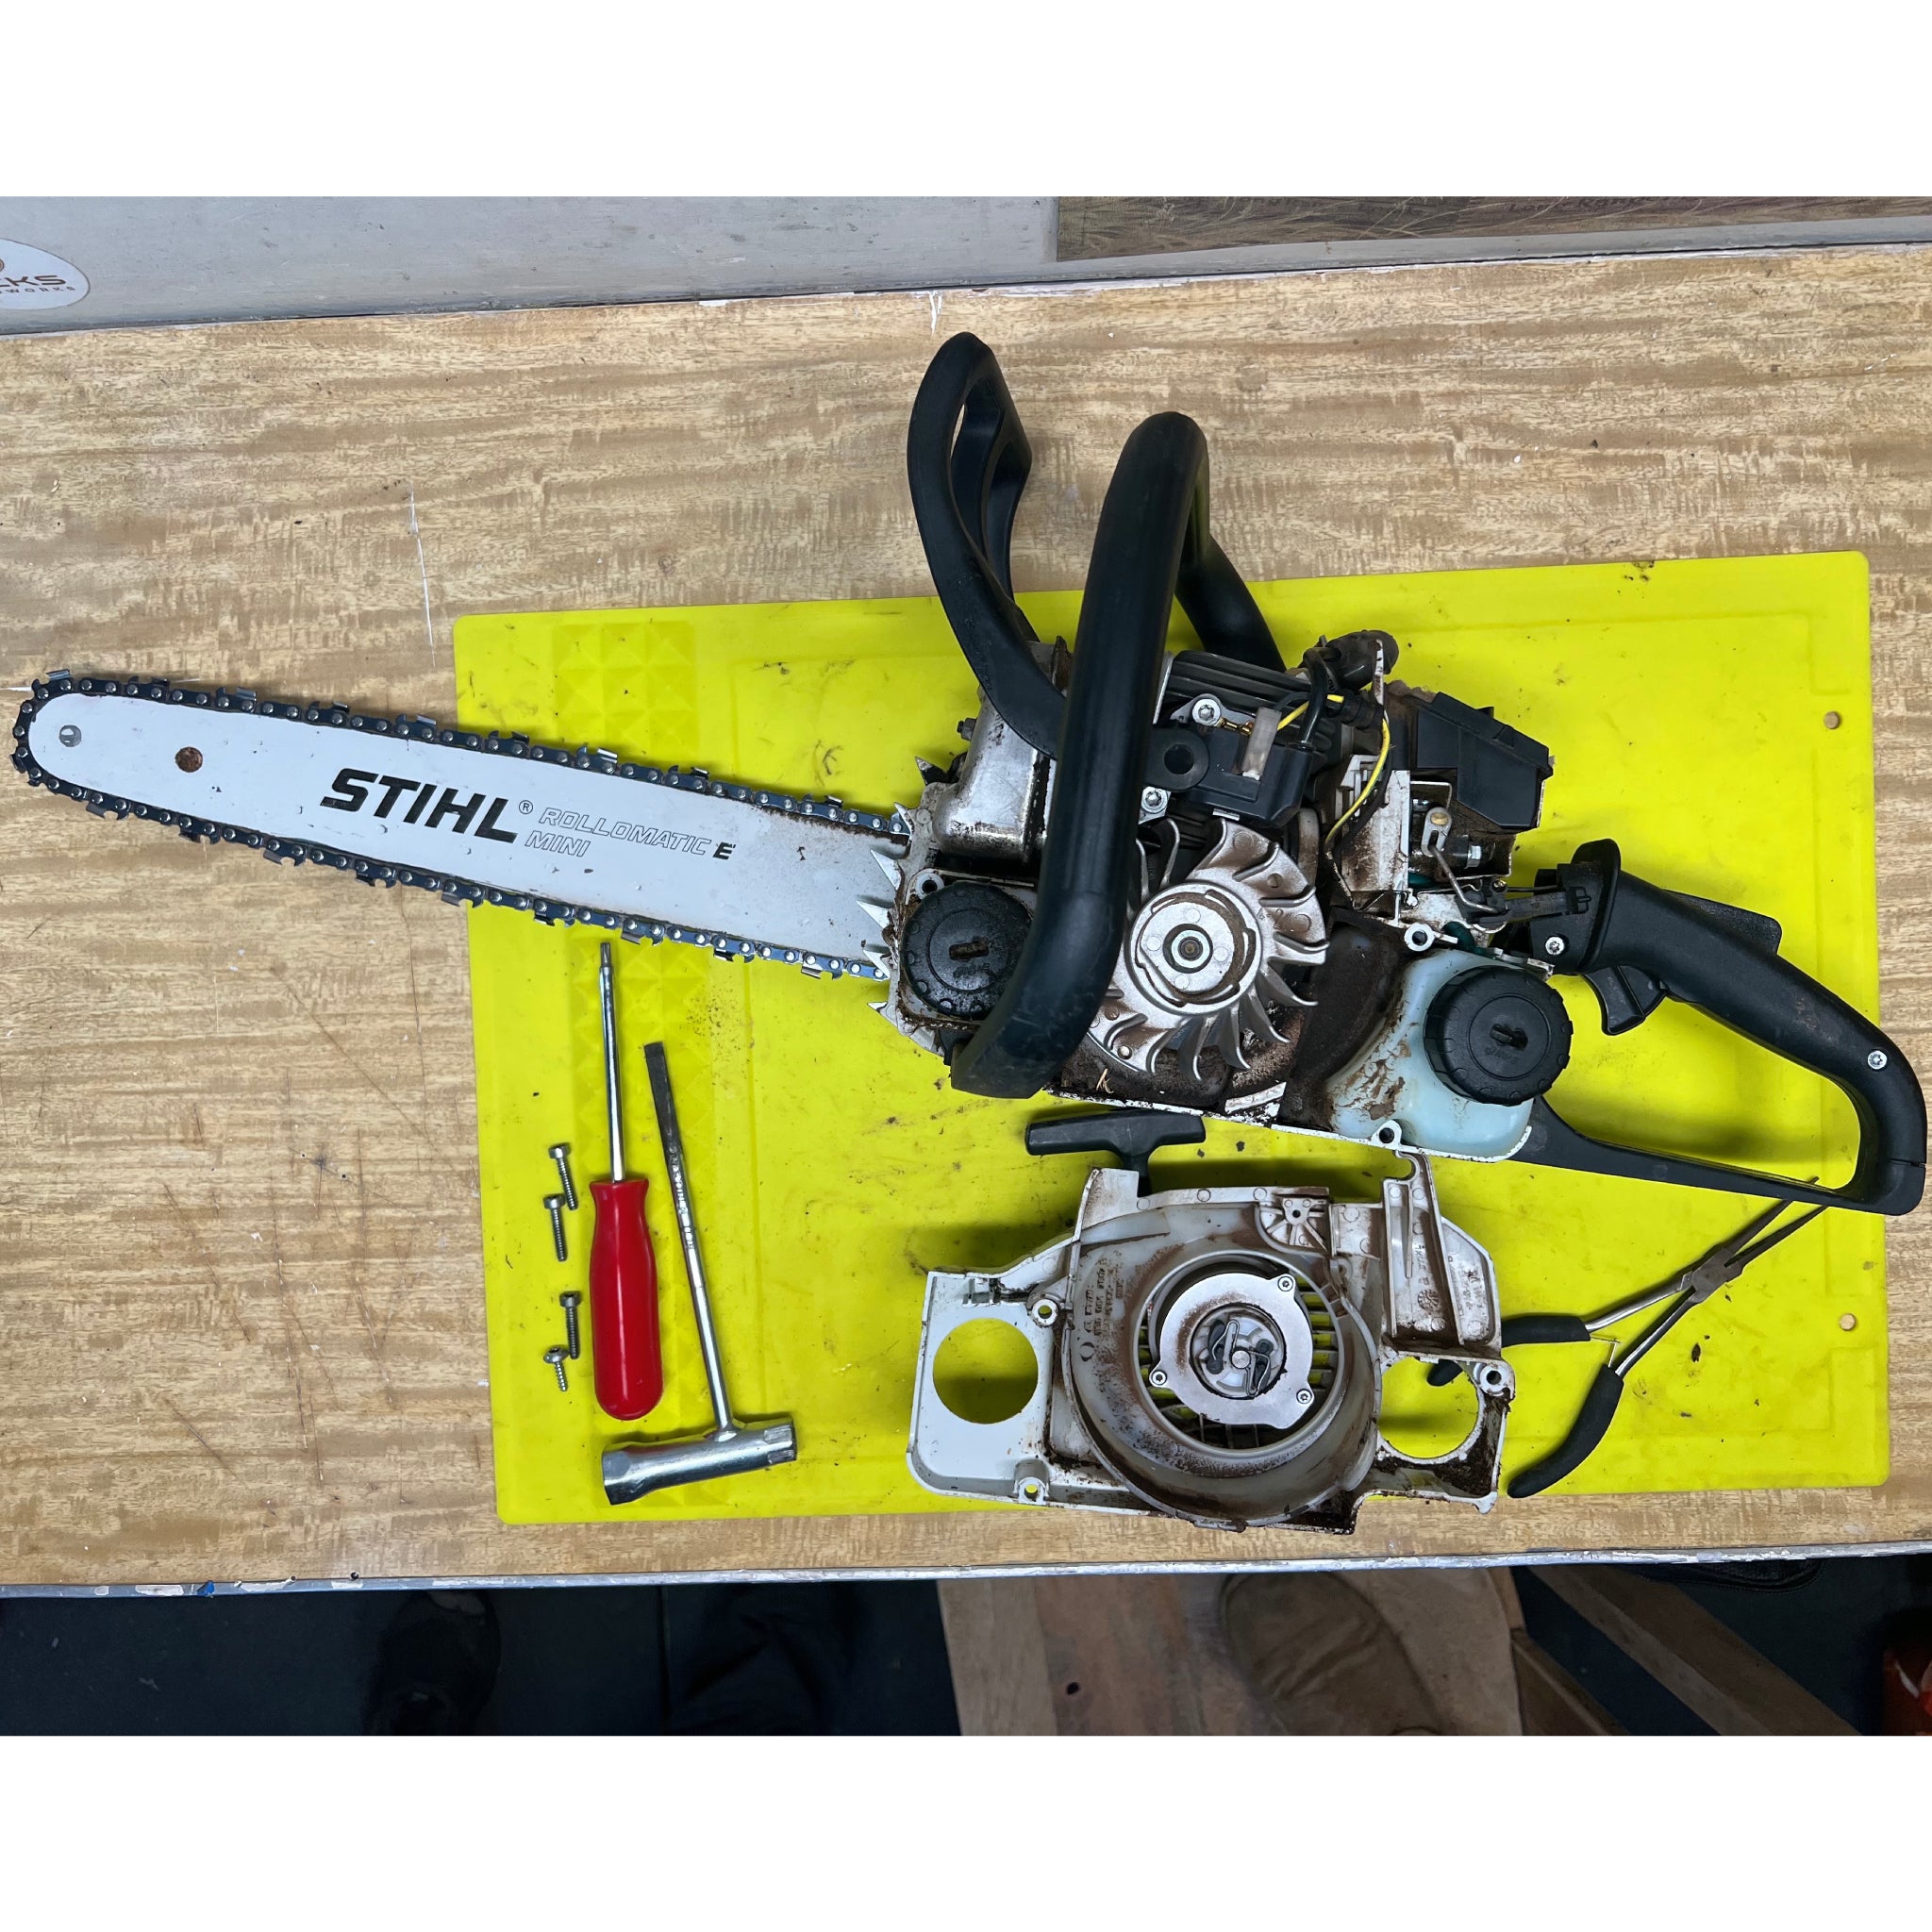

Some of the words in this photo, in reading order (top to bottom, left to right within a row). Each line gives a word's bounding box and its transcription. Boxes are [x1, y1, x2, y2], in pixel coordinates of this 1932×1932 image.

[525, 830, 591, 858] MINI
[539, 807, 712, 856] ROLLOMATIC
[712, 841, 736, 860] E
